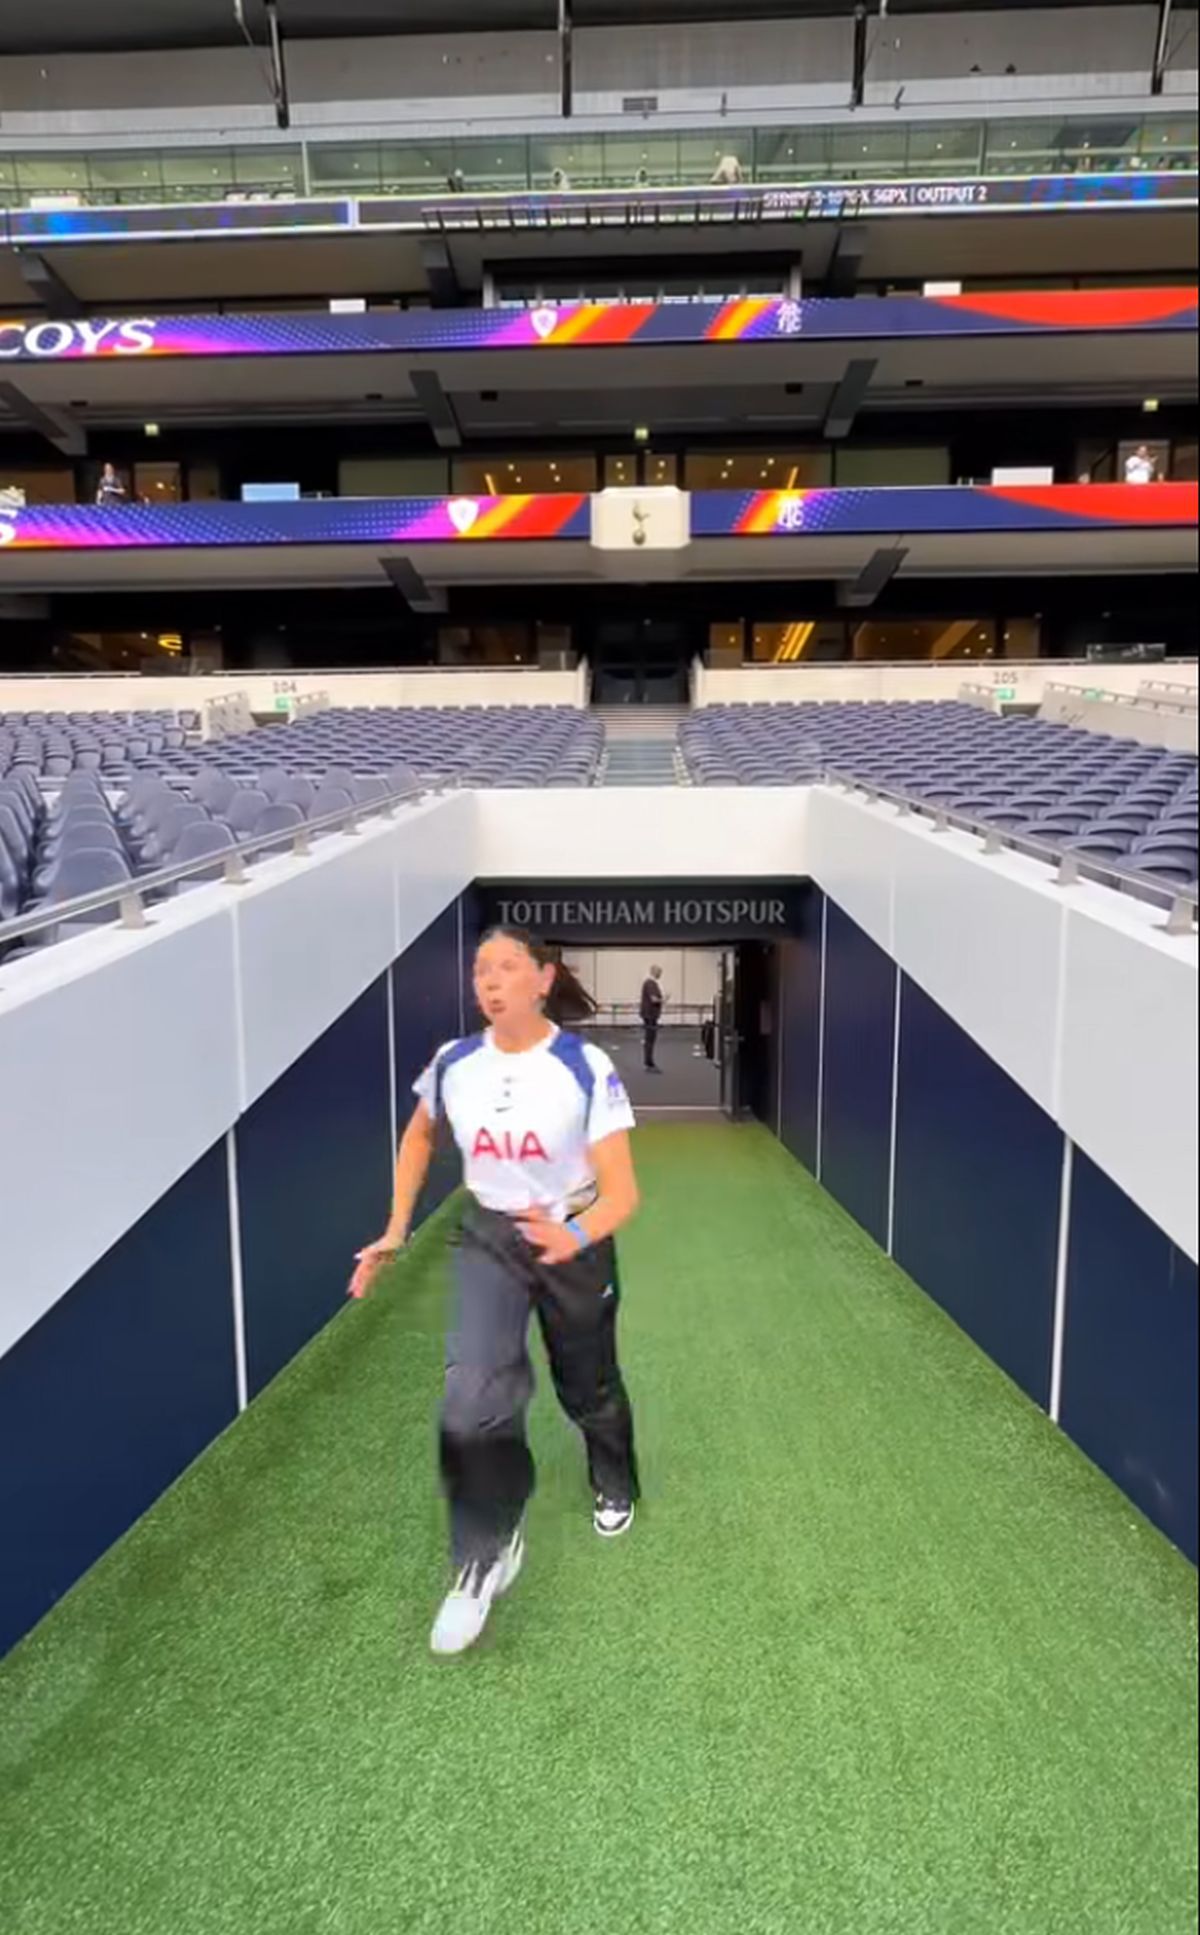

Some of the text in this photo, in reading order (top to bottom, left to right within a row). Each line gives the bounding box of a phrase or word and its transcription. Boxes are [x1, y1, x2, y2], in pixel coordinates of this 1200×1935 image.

[917, 186, 975, 202] OUTPUT
[978, 186, 988, 201] 2
[497, 900, 786, 924] TOTTENHAM HOTSPUR
[472, 1126, 550, 1161] AIA
